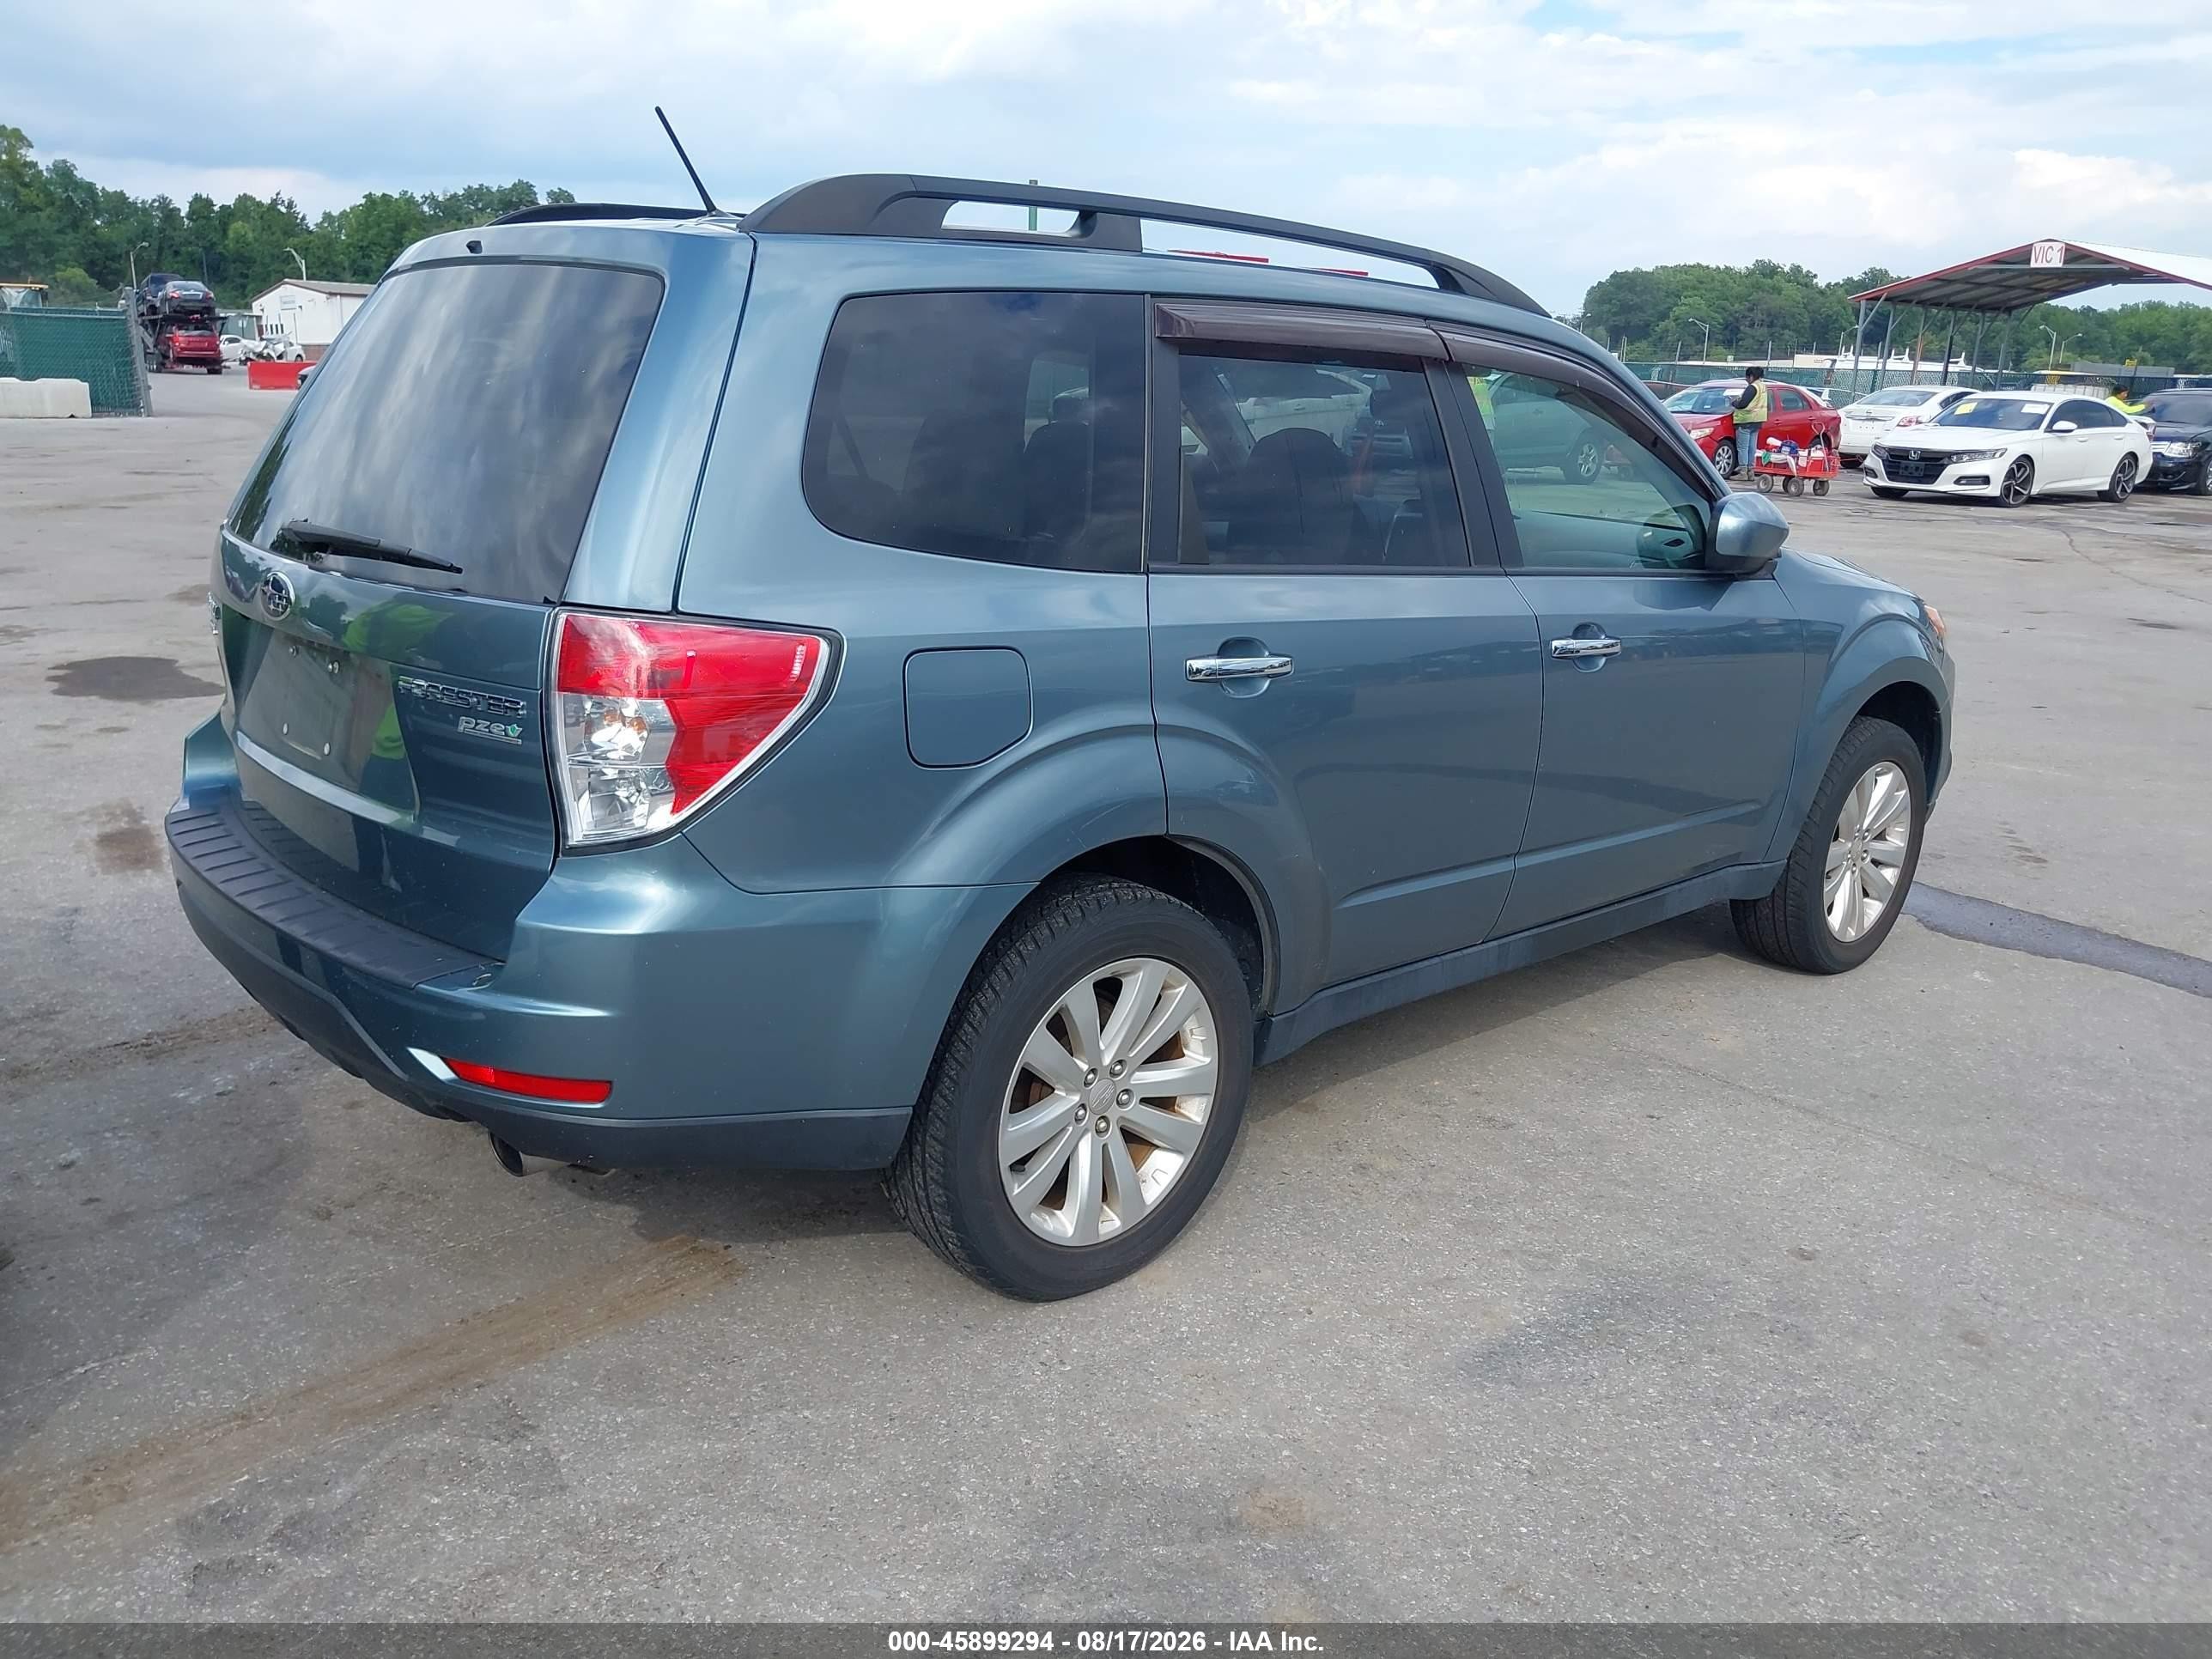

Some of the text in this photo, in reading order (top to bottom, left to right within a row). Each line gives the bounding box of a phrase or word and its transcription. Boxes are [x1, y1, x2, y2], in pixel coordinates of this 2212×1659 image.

[2033, 246, 2064, 264] VIC 1
[398, 675, 526, 718] FORESTER
